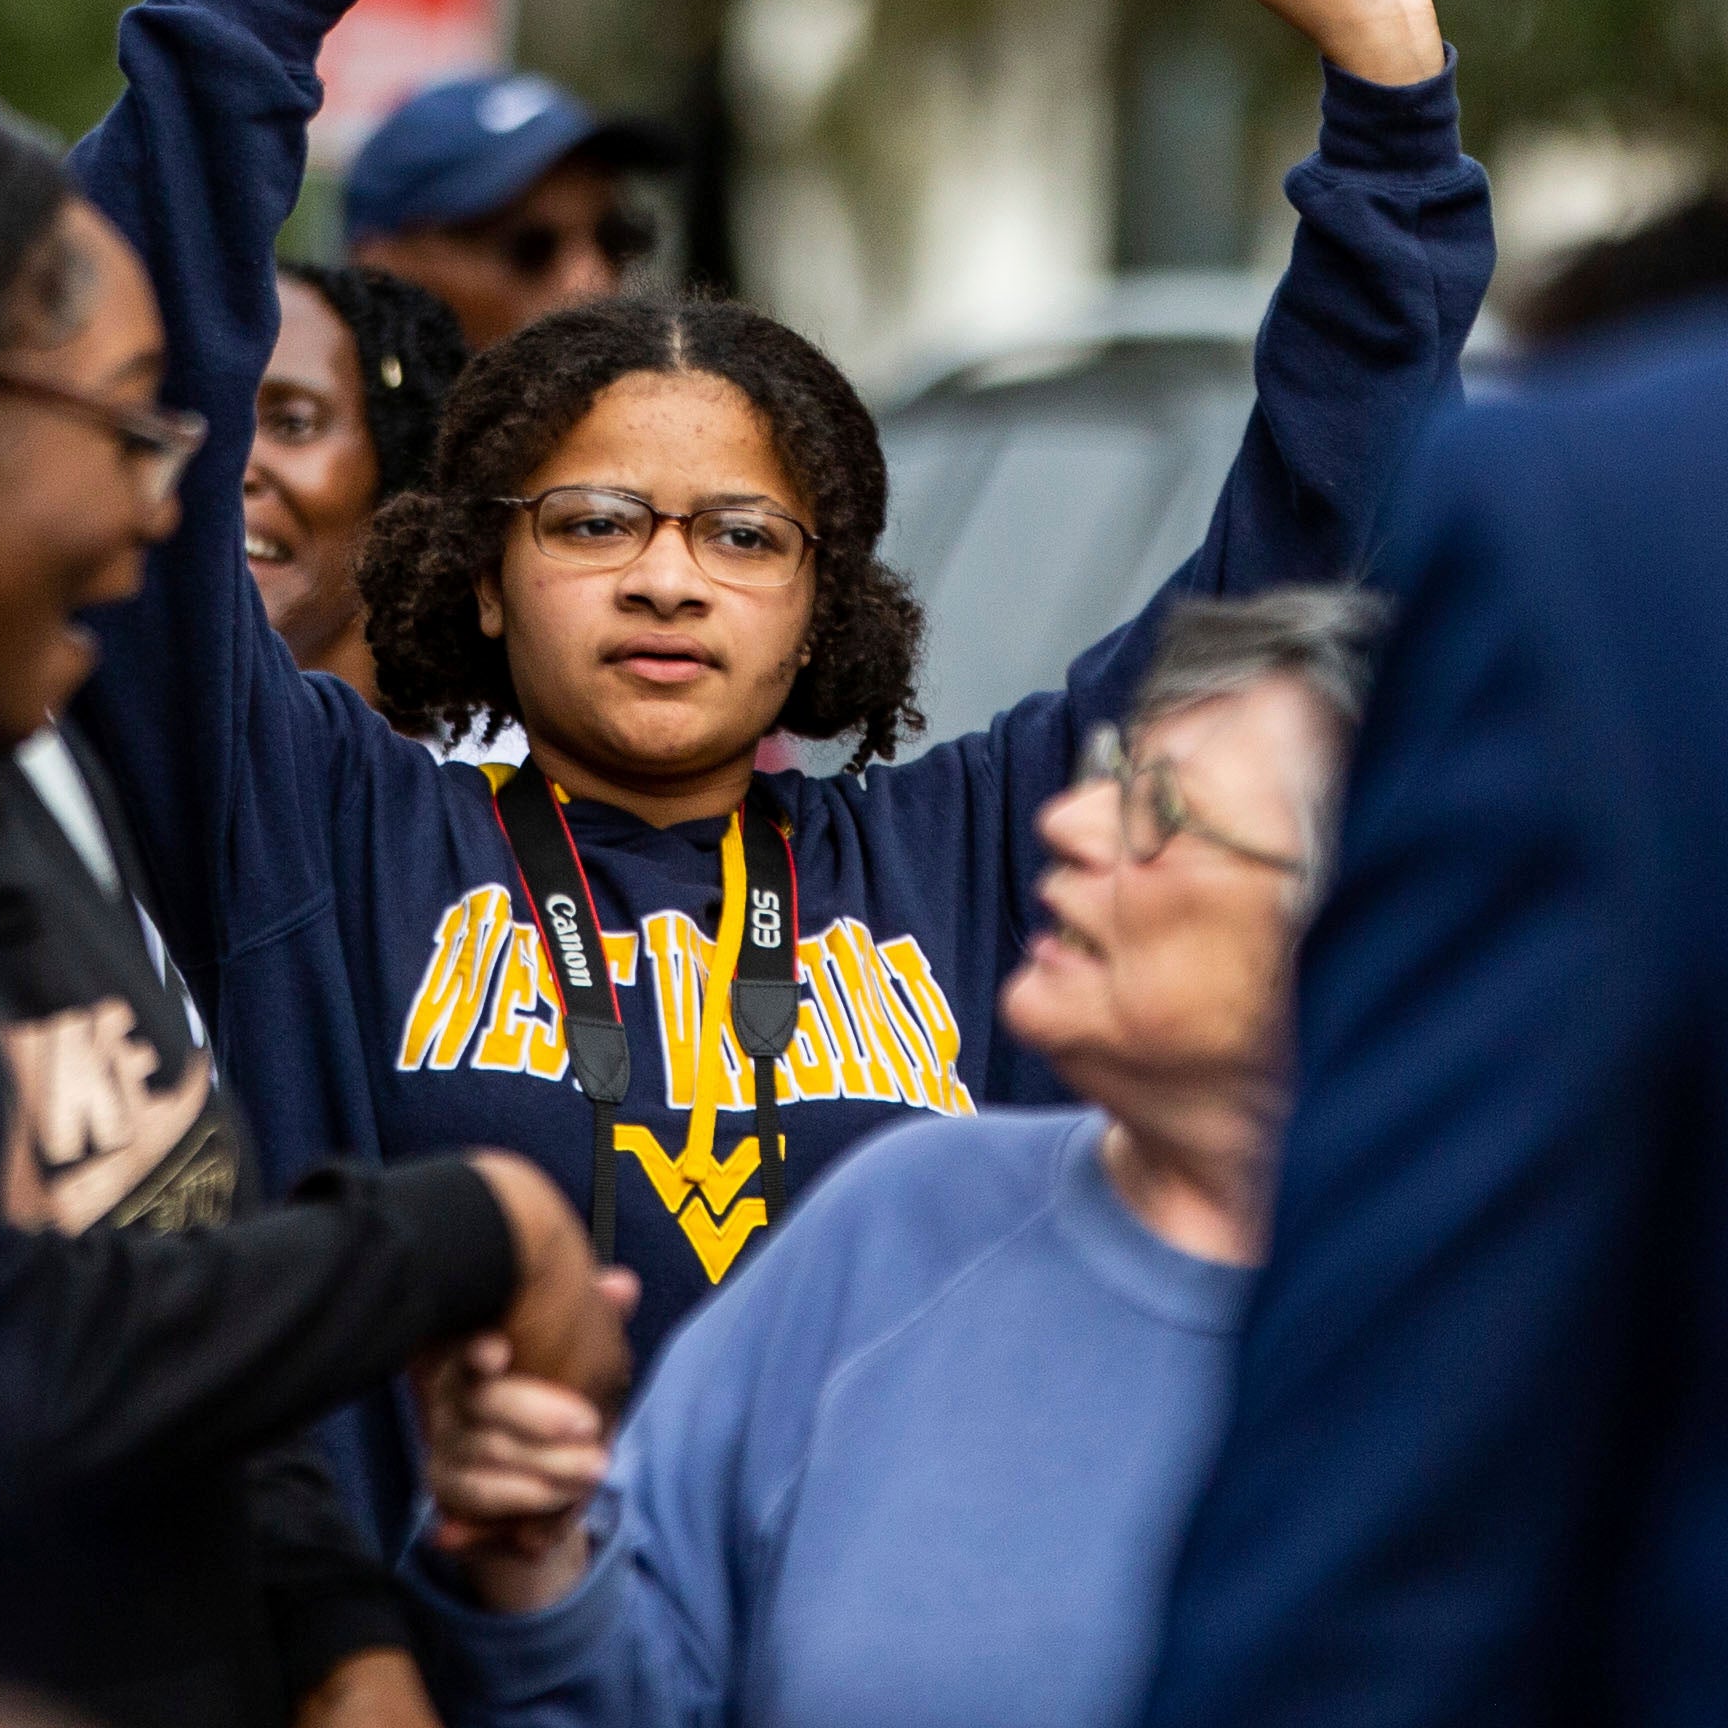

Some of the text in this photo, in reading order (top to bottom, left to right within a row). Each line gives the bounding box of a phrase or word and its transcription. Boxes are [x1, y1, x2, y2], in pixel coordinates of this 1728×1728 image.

[545, 893, 593, 988] Canon
[751, 888, 782, 949] EOS
[640, 908, 978, 1118] VGINIA
